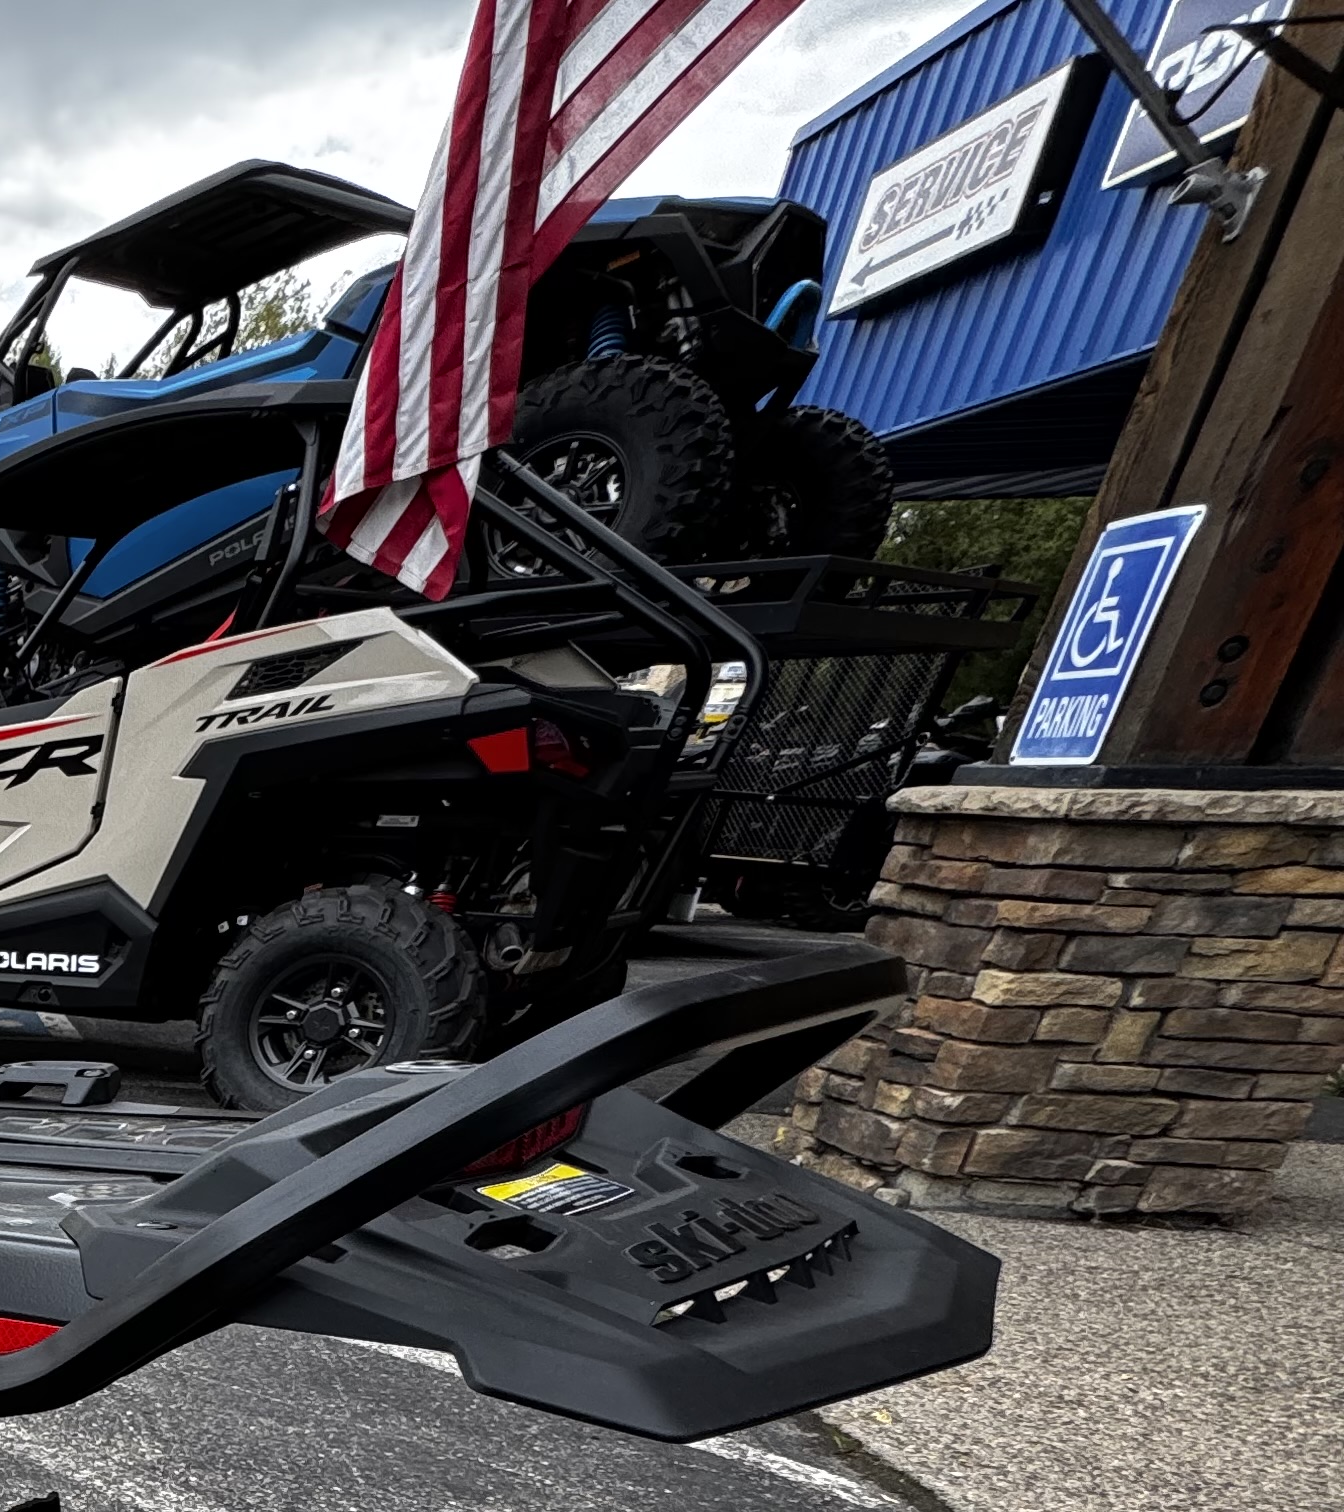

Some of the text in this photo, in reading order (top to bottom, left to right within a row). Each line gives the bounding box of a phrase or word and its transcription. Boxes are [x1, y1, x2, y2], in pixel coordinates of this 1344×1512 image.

[859, 98, 1048, 254] SERVICE
[195, 693, 335, 733] TRAIL
[1027, 693, 1109, 739] PARKING
